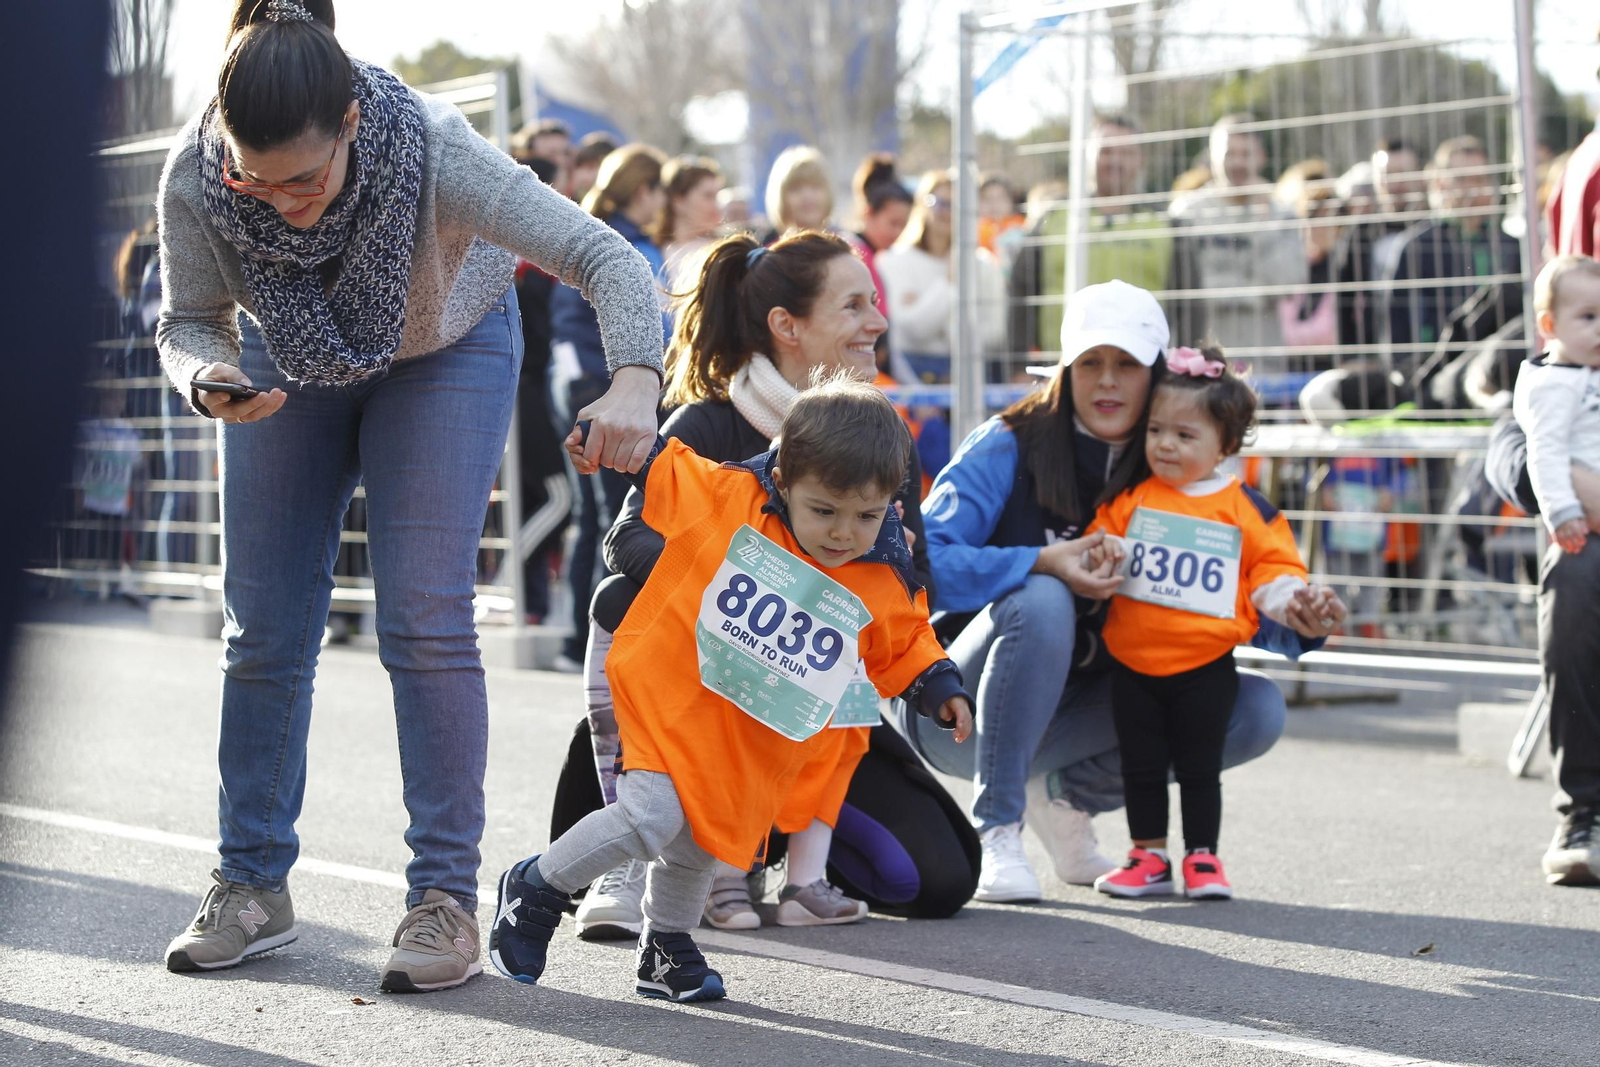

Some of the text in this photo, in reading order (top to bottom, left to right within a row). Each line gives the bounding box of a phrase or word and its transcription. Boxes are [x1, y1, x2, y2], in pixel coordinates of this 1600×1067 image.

[1195, 527, 1234, 541] CARRERA
[758, 566, 788, 589] ALMERÍA
[763, 559, 797, 584] MARATÓN
[1130, 542, 1225, 593] 8306
[822, 589, 860, 618] CARRER
[1151, 585, 1181, 597] ALMA
[716, 574, 844, 671] 8039
[721, 620, 757, 650] BORN
[760, 643, 778, 661] TO
[779, 658, 808, 678] RUN
[728, 639, 742, 651] DAVID
[742, 647, 768, 667] RODRIGUEZ
[767, 662, 790, 679] MARTINEZ
